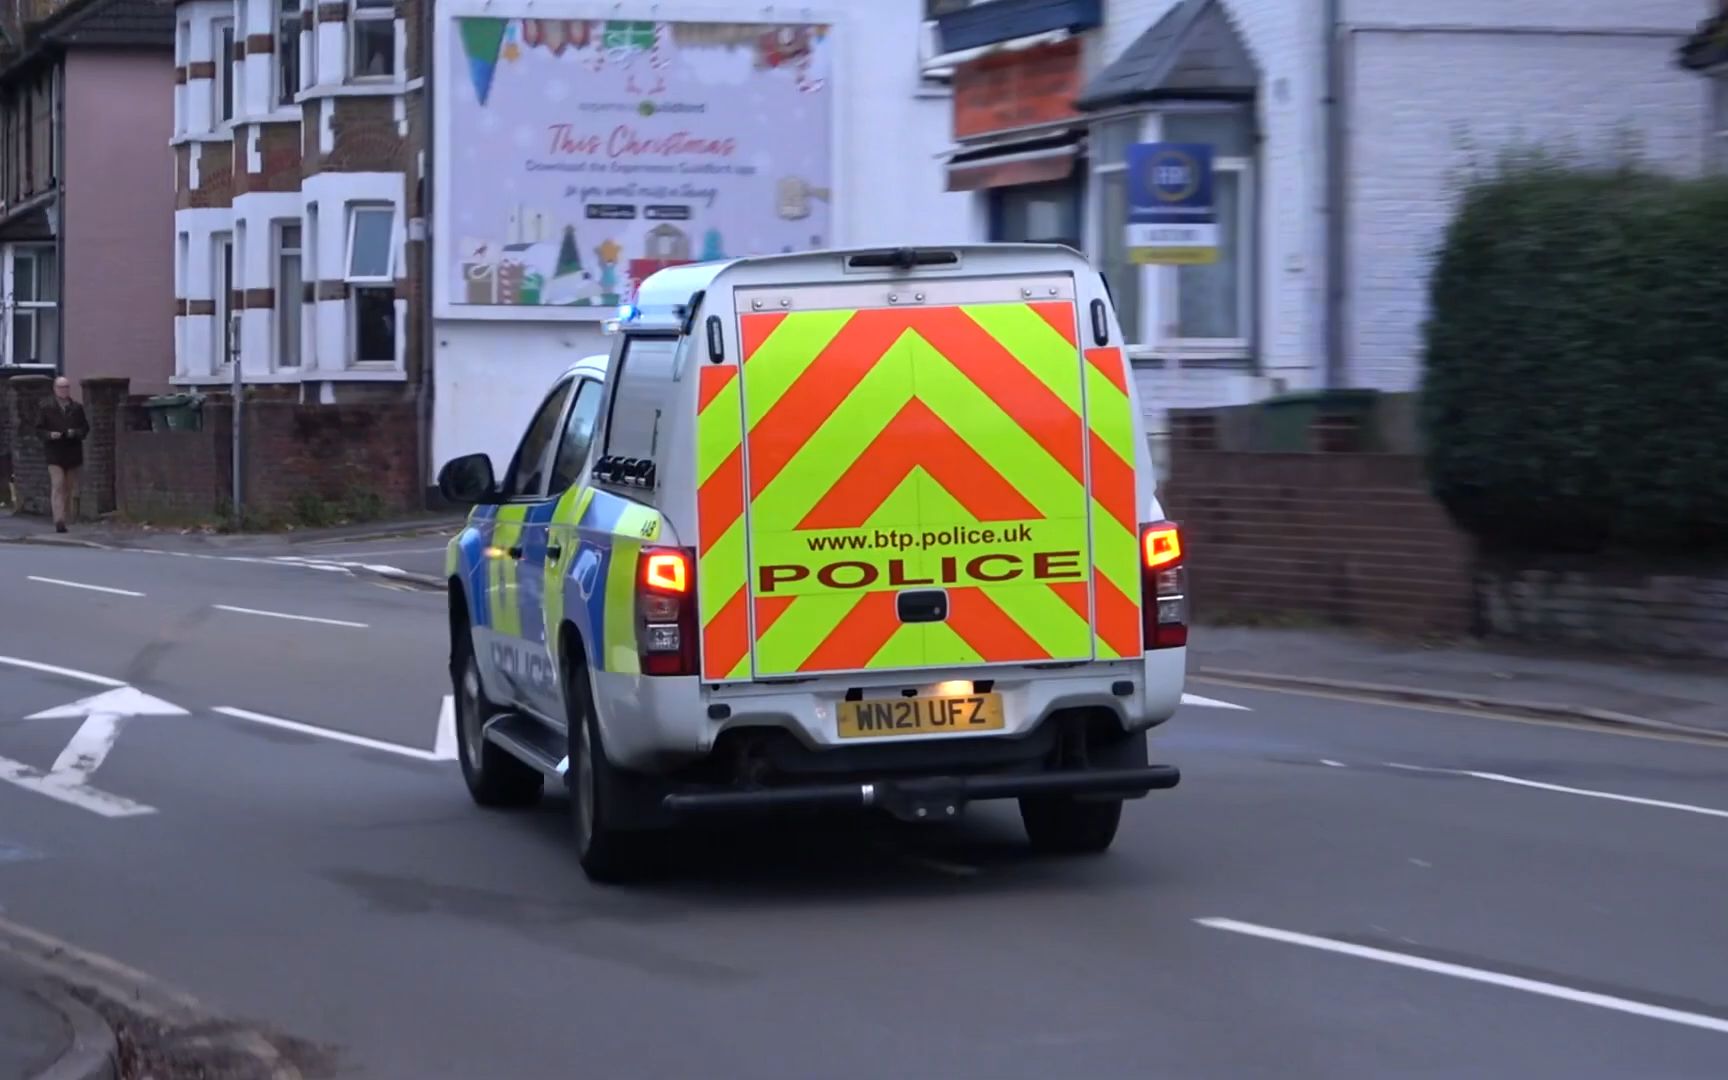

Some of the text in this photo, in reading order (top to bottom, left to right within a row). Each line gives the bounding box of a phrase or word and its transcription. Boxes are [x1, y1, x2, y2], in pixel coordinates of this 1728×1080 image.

[548, 123, 737, 158] This Christmas
[807, 523, 1033, 552] www.btp.police.uk
[758, 551, 1082, 592] POLICE
[856, 697, 986, 731] WN21 UFZ
